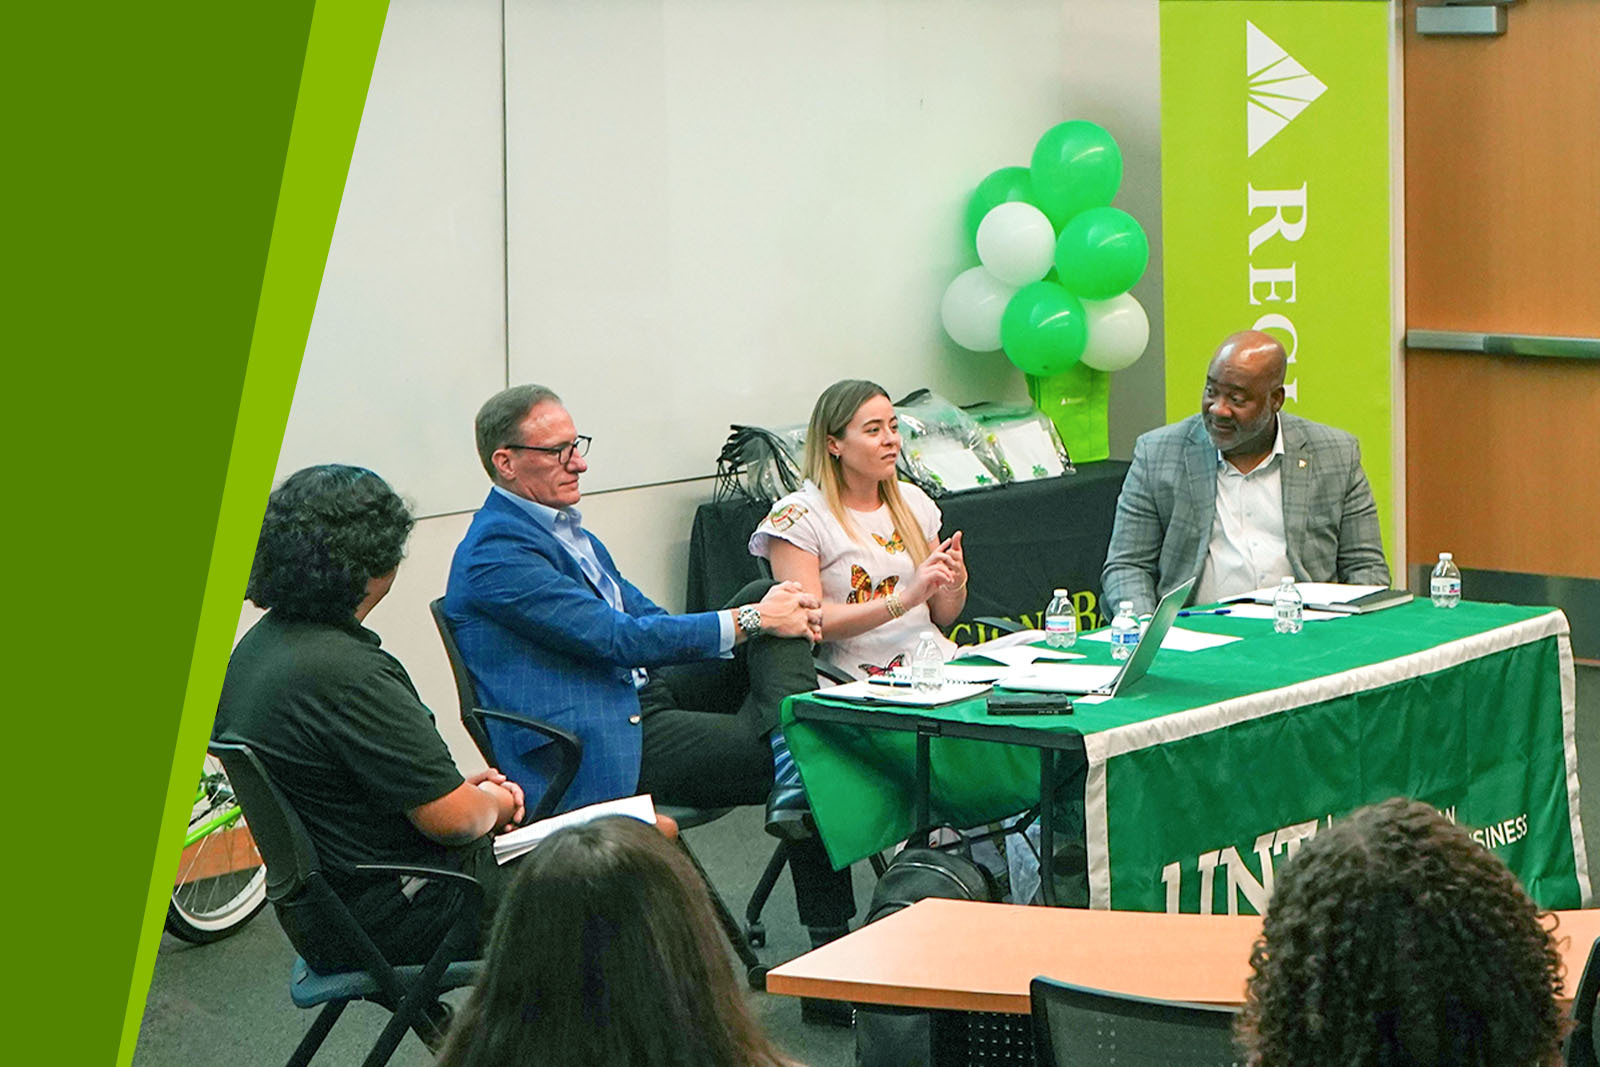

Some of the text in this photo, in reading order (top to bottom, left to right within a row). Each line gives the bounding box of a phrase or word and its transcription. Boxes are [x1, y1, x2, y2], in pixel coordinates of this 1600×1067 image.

[1247, 181, 1308, 403] RE
[1072, 590, 1104, 633] B
[1468, 813, 1528, 850] SINESS
[1161, 819, 1319, 915] UNT
